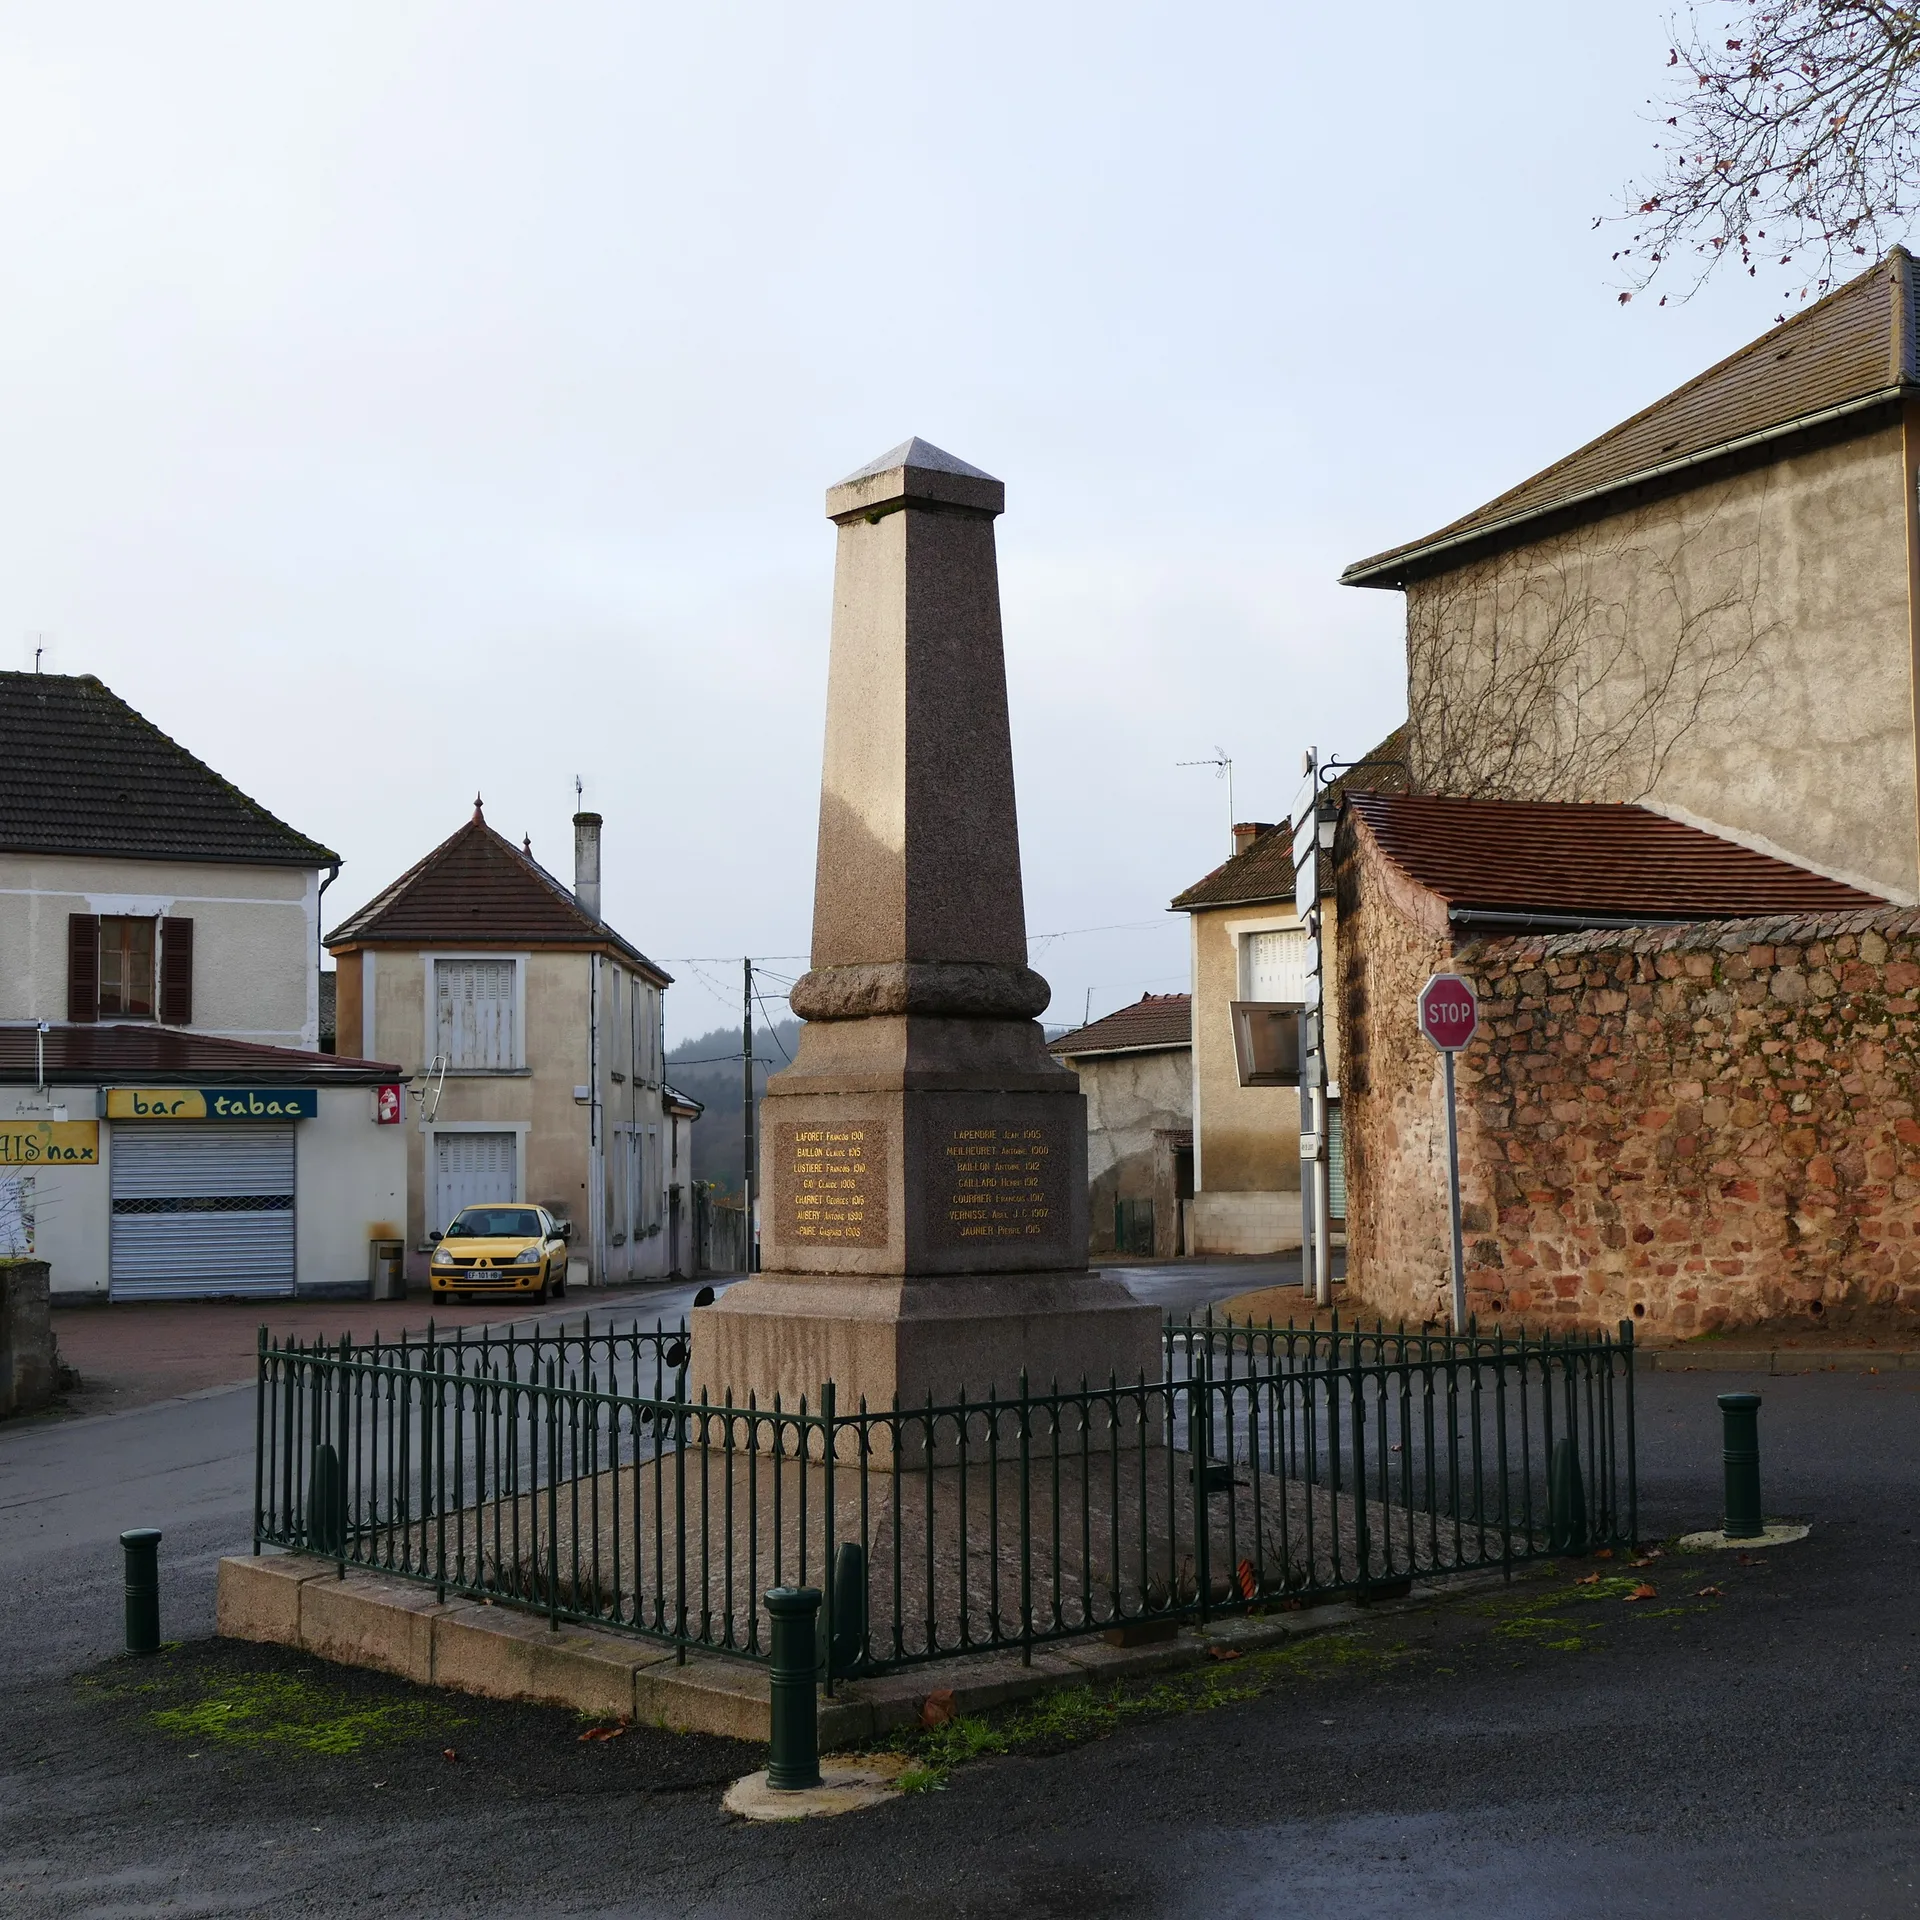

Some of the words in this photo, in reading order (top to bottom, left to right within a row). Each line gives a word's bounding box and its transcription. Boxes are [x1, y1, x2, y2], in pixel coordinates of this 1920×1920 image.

[1429, 1003, 1471, 1023] STOP
[133, 1092, 185, 1116] bar
[214, 1092, 302, 1116] tabac
[796, 1131, 824, 1142] LAFORET
[851, 1130, 864, 1141] 1901
[797, 1147, 823, 1157] BAILLON
